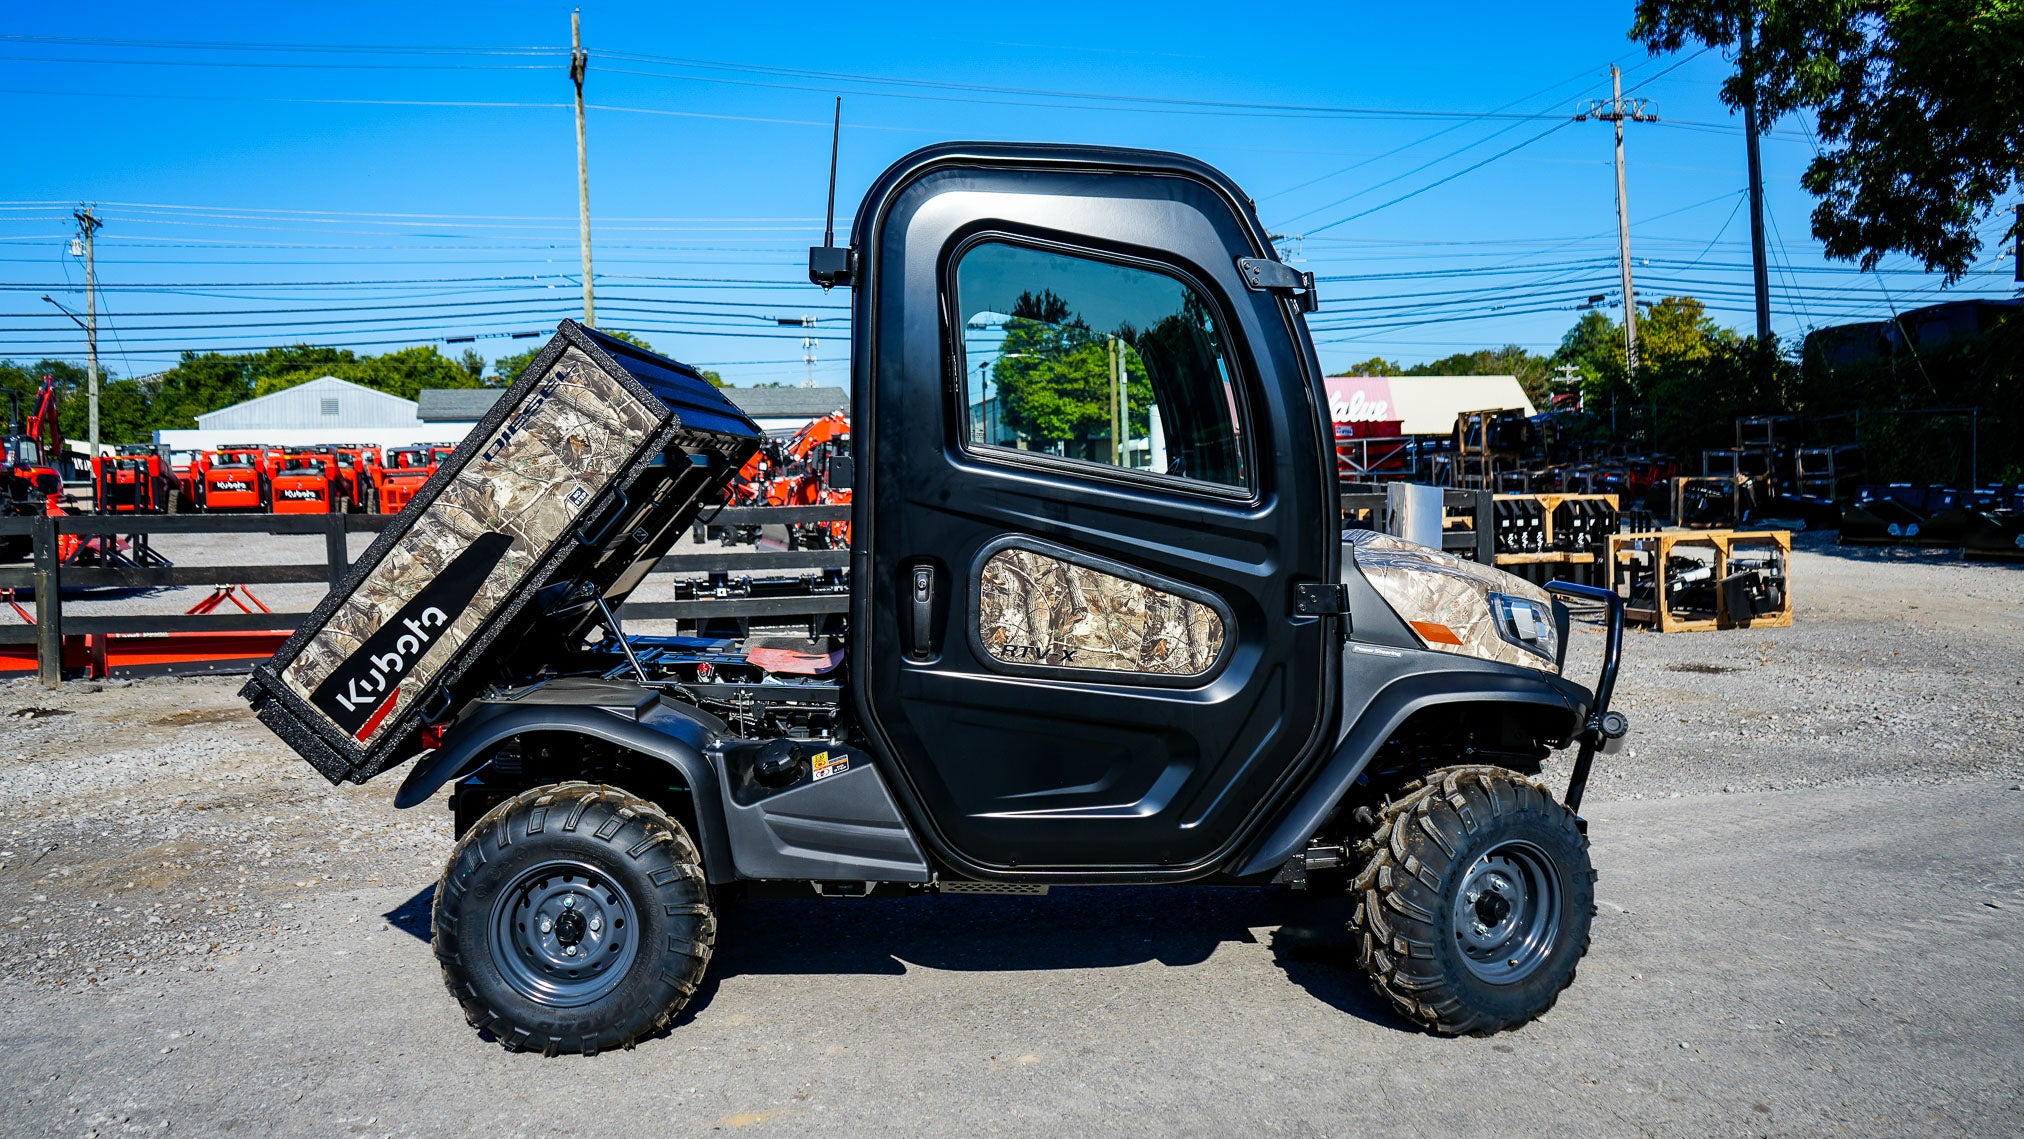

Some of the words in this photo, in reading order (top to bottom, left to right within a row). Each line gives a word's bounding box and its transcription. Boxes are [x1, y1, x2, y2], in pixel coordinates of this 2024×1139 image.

[482, 364, 577, 462] DIESEL
[216, 481, 246, 489] Kubota
[284, 489, 316, 498] Kubota
[572, 490, 581, 499] NO
[575, 492, 587, 504] STEP
[1000, 643, 1078, 662] RTV-X
[335, 606, 449, 712] Kubota
